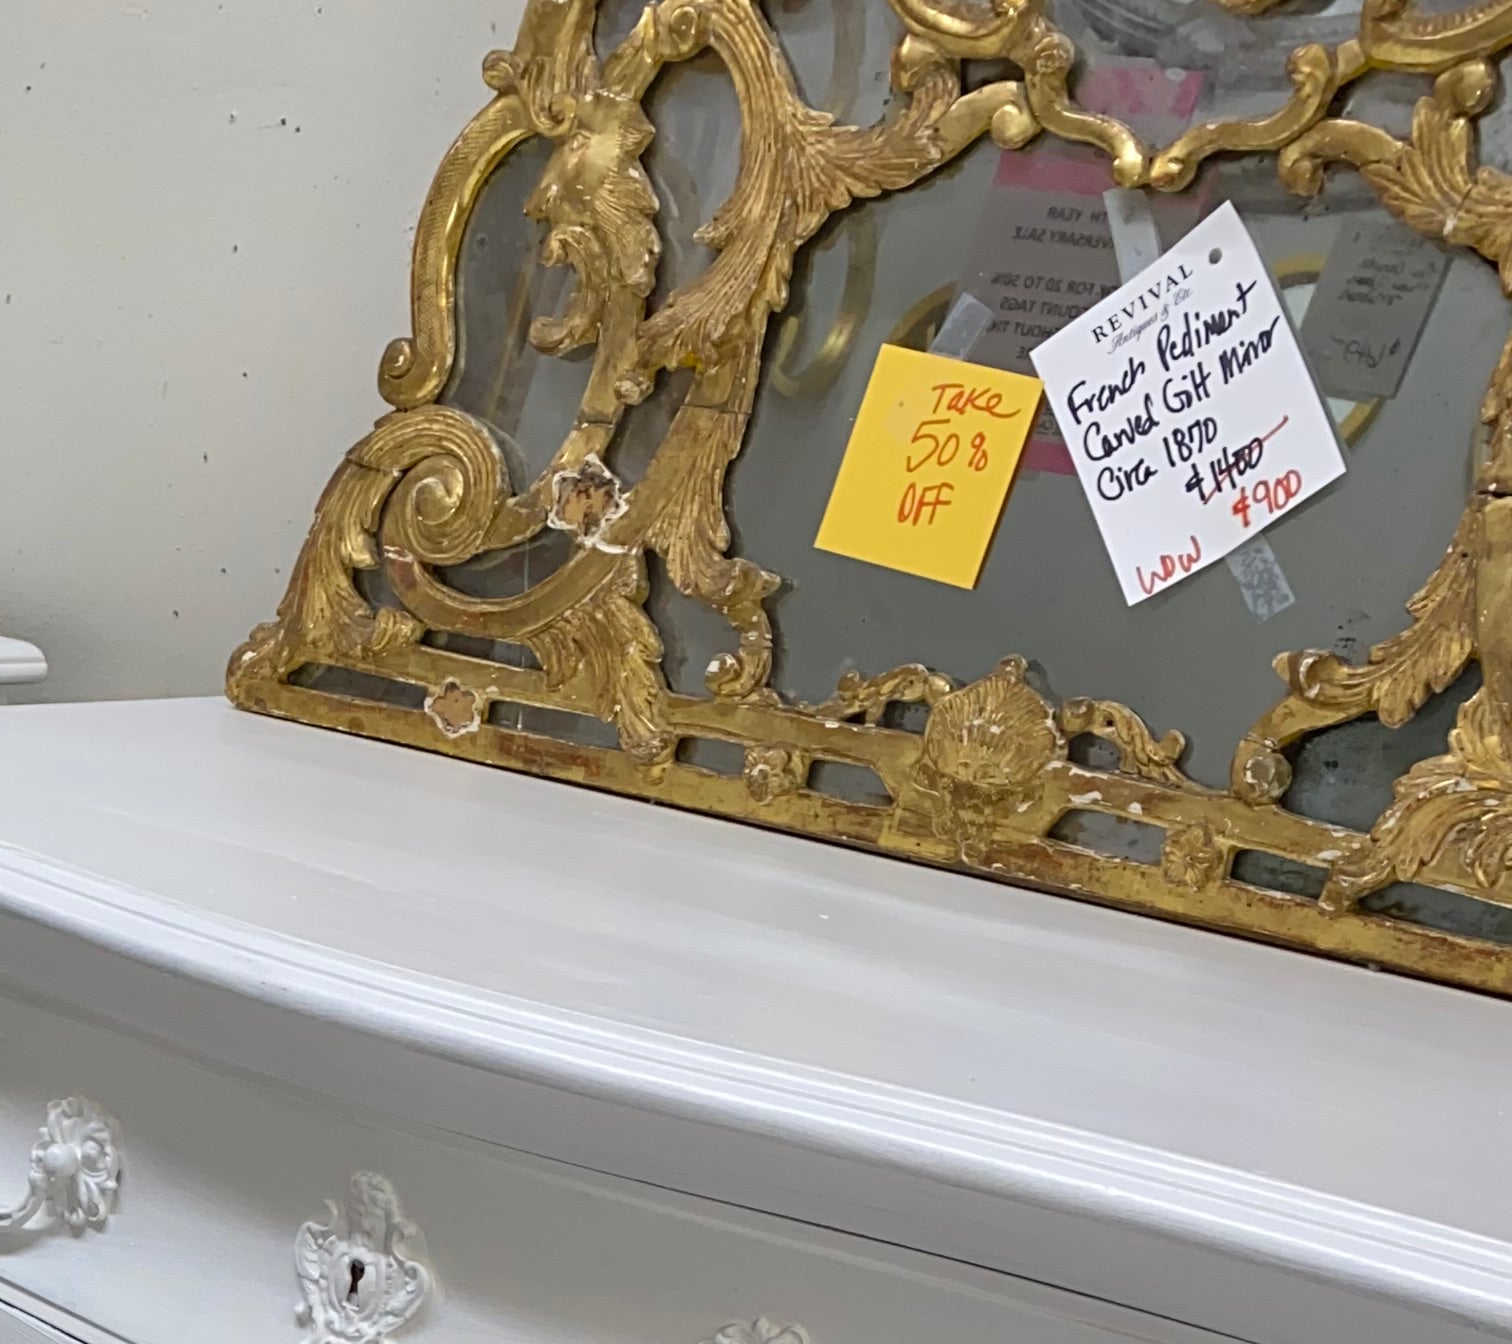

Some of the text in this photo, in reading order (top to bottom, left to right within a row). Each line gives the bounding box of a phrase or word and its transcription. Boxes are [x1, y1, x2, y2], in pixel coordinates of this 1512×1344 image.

[1091, 263, 1194, 344] REVIVAL
[1066, 357, 1146, 425] French
[1083, 392, 1160, 461] Carved
[1096, 416, 1218, 502] Circa 1870
[896, 481, 956, 528] OFF
[1231, 468, 1303, 529] $900
